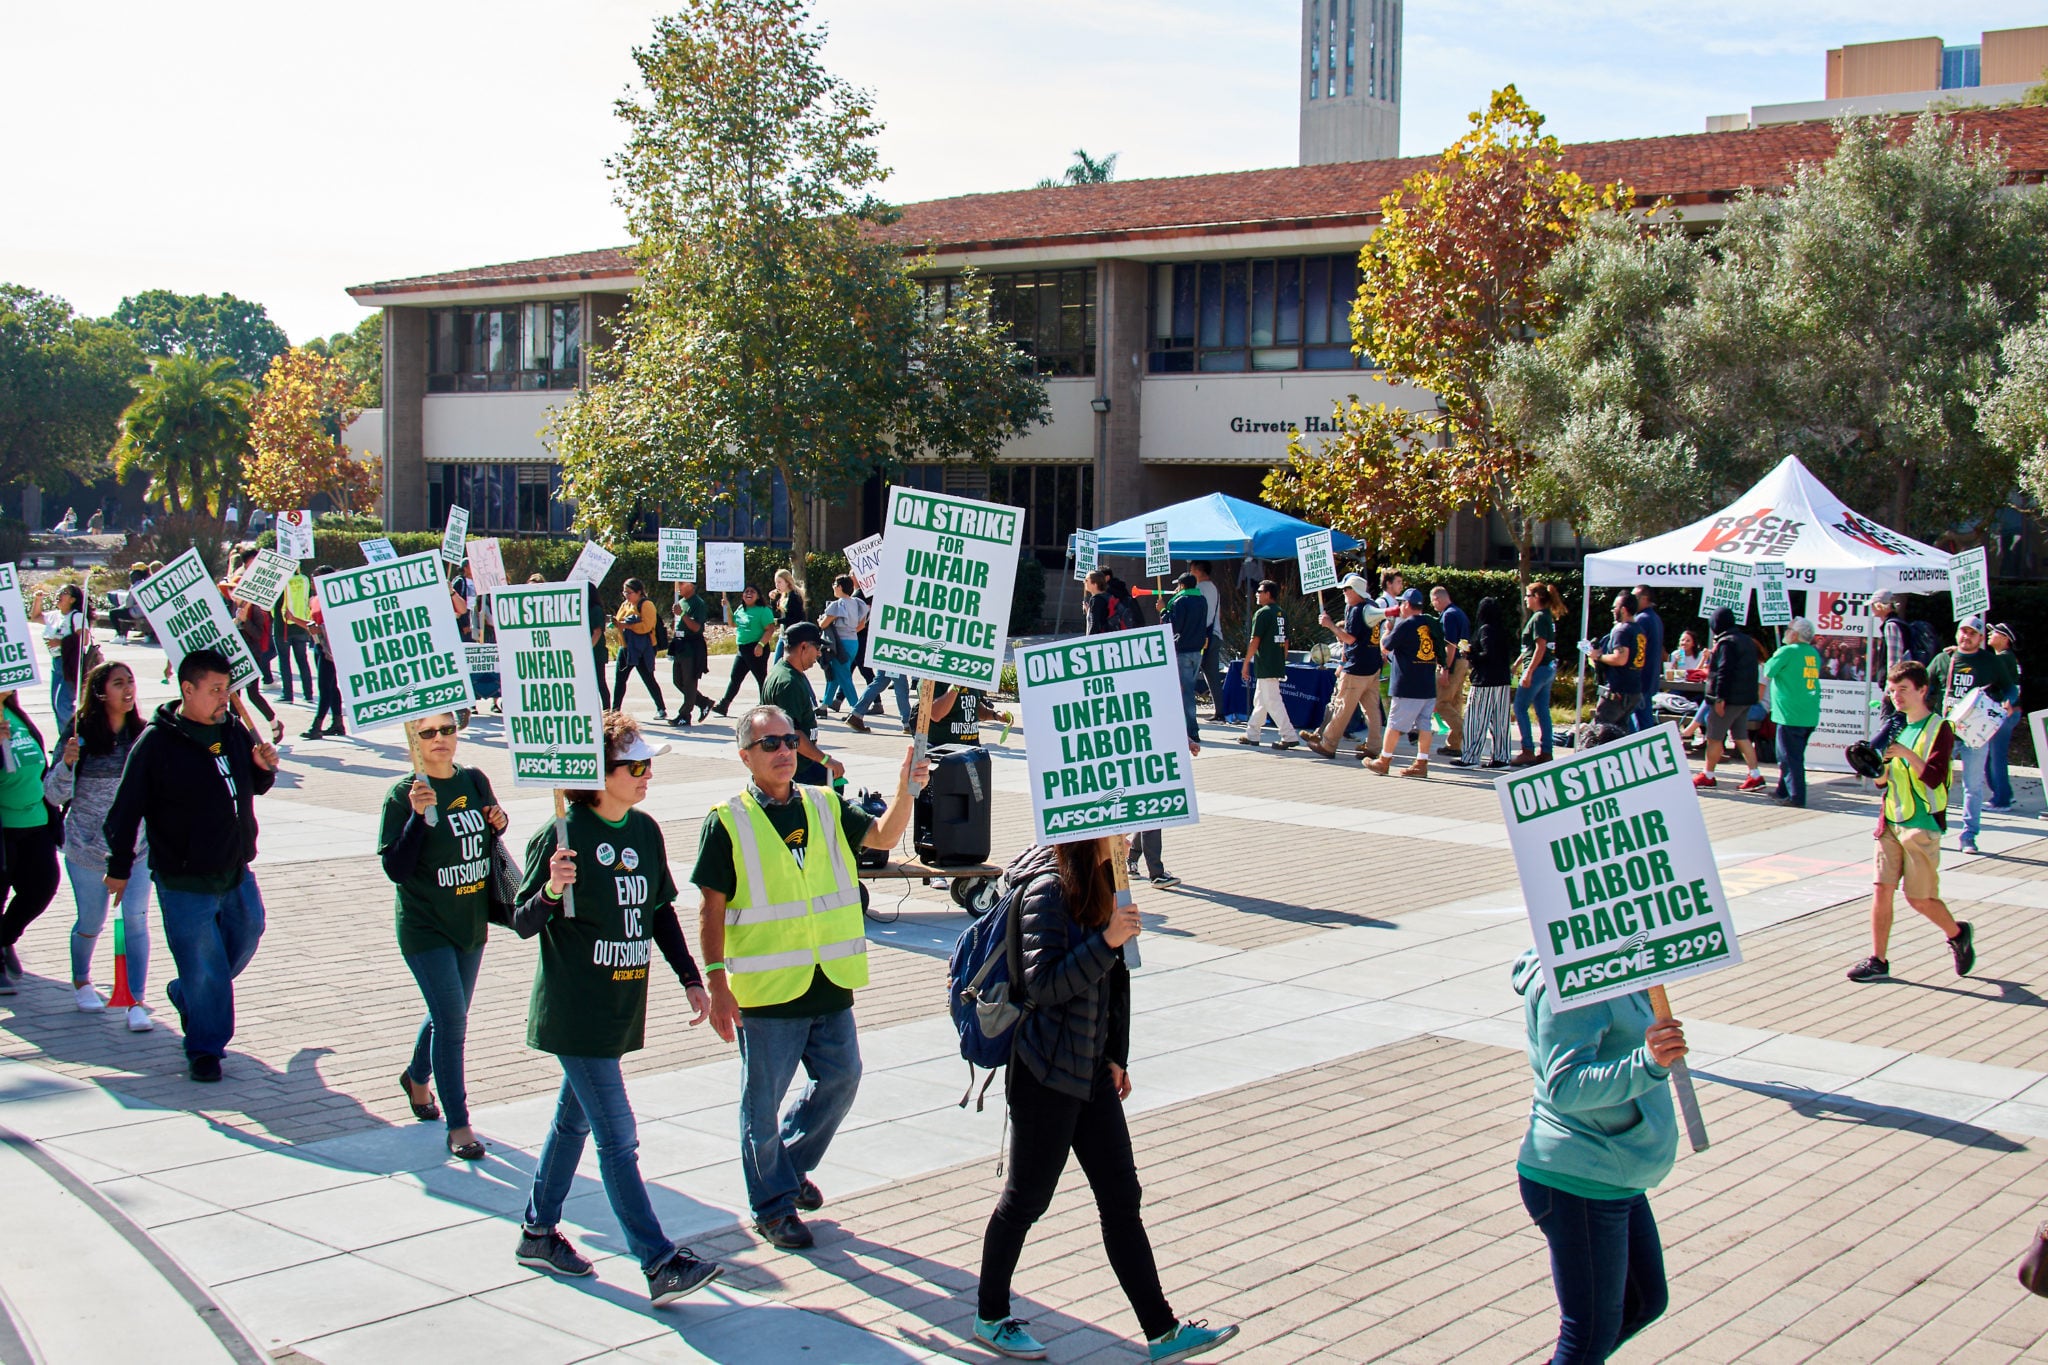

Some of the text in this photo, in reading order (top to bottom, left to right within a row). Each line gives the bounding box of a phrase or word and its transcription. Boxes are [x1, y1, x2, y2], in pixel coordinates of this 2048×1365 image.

[1231, 417, 1296, 432] Girvetz
[898, 497, 1013, 541] ON STRIKE
[1713, 515, 1805, 534] ROCK
[667, 546, 689, 554] UNFAIR
[938, 536, 965, 555] FOR
[1150, 538, 1165, 547] UNFAIR
[1735, 528, 1798, 546] THE
[668, 554, 688, 562] LABOR
[1148, 555, 1168, 565] PRACTICE
[1151, 547, 1164, 556] LABOR
[1305, 550, 1326, 562] UNFAIR
[256, 567, 283, 581] UNFAIR
[662, 562, 693, 571] PRACTICE
[907, 549, 989, 588] UNFAIR
[1304, 566, 1333, 581] PRACTICE
[1307, 559, 1327, 571] LABOR
[142, 559, 202, 609] ON STRIKE
[241, 580, 278, 598] PRACTICE
[252, 574, 277, 588] LABOR
[328, 575, 360, 602] ON
[362, 560, 439, 595] STRIKE
[859, 574, 876, 590] NOT
[1714, 578, 1743, 591] UNFAIR
[1763, 582, 1783, 591] UNFAIR
[173, 594, 189, 611] FOR
[374, 598, 400, 614] FOR
[905, 579, 981, 616] LABOR
[1713, 588, 1740, 601] LABOR
[1762, 602, 1789, 611] PRACTICE
[1765, 592, 1783, 601] LABOR
[166, 599, 213, 638] UNFAIR
[499, 593, 581, 628] ON STRIKE
[1818, 614, 1863, 632] SB.org
[351, 606, 432, 643] UNFAIR
[881, 605, 996, 650] PRACTICE
[178, 620, 220, 656] LABOR
[361, 632, 434, 668] LABOR
[532, 631, 552, 649] FOR
[231, 661, 250, 679] 3299
[516, 651, 575, 681] UNFAIR
[875, 645, 946, 668] AFSCME
[950, 658, 991, 676] 3299
[1028, 651, 1065, 682] ON
[1070, 635, 1164, 675] STRIKE
[1, 668, 32, 682] 3299
[350, 653, 459, 698] PRACTICE
[1083, 677, 1115, 697] FOR
[1953, 673, 1973, 686] END
[358, 695, 421, 721] AFSCME
[425, 684, 464, 706] 3299
[522, 684, 576, 713] LABOR
[1954, 686, 1968, 697] UC
[1054, 692, 1152, 732] UNFAIR
[513, 717, 594, 745] PRACTICE
[1062, 724, 1152, 764] LABOR
[518, 758, 596, 774] AFSCME 3299
[1043, 752, 1180, 799] PRACTICE
[1514, 738, 1674, 815] ON STRIKE
[448, 809, 485, 837] END
[1047, 803, 1128, 829] AFSCME
[1136, 795, 1184, 816] 3299
[1581, 797, 1620, 825] FOR
[461, 834, 483, 860] UC
[1550, 810, 1669, 872] UNFAIR
[437, 858, 490, 887] OUTSOURC
[1565, 849, 1674, 909] LABOR
[615, 875, 648, 905] END
[624, 908, 642, 938] UC
[1548, 878, 1713, 955] PRACTICE
[593, 939, 652, 967] OUTSOURC
[1561, 949, 1655, 991] AFSCME
[1664, 931, 1721, 962] 3299
[612, 970, 633, 980] AFSCME
